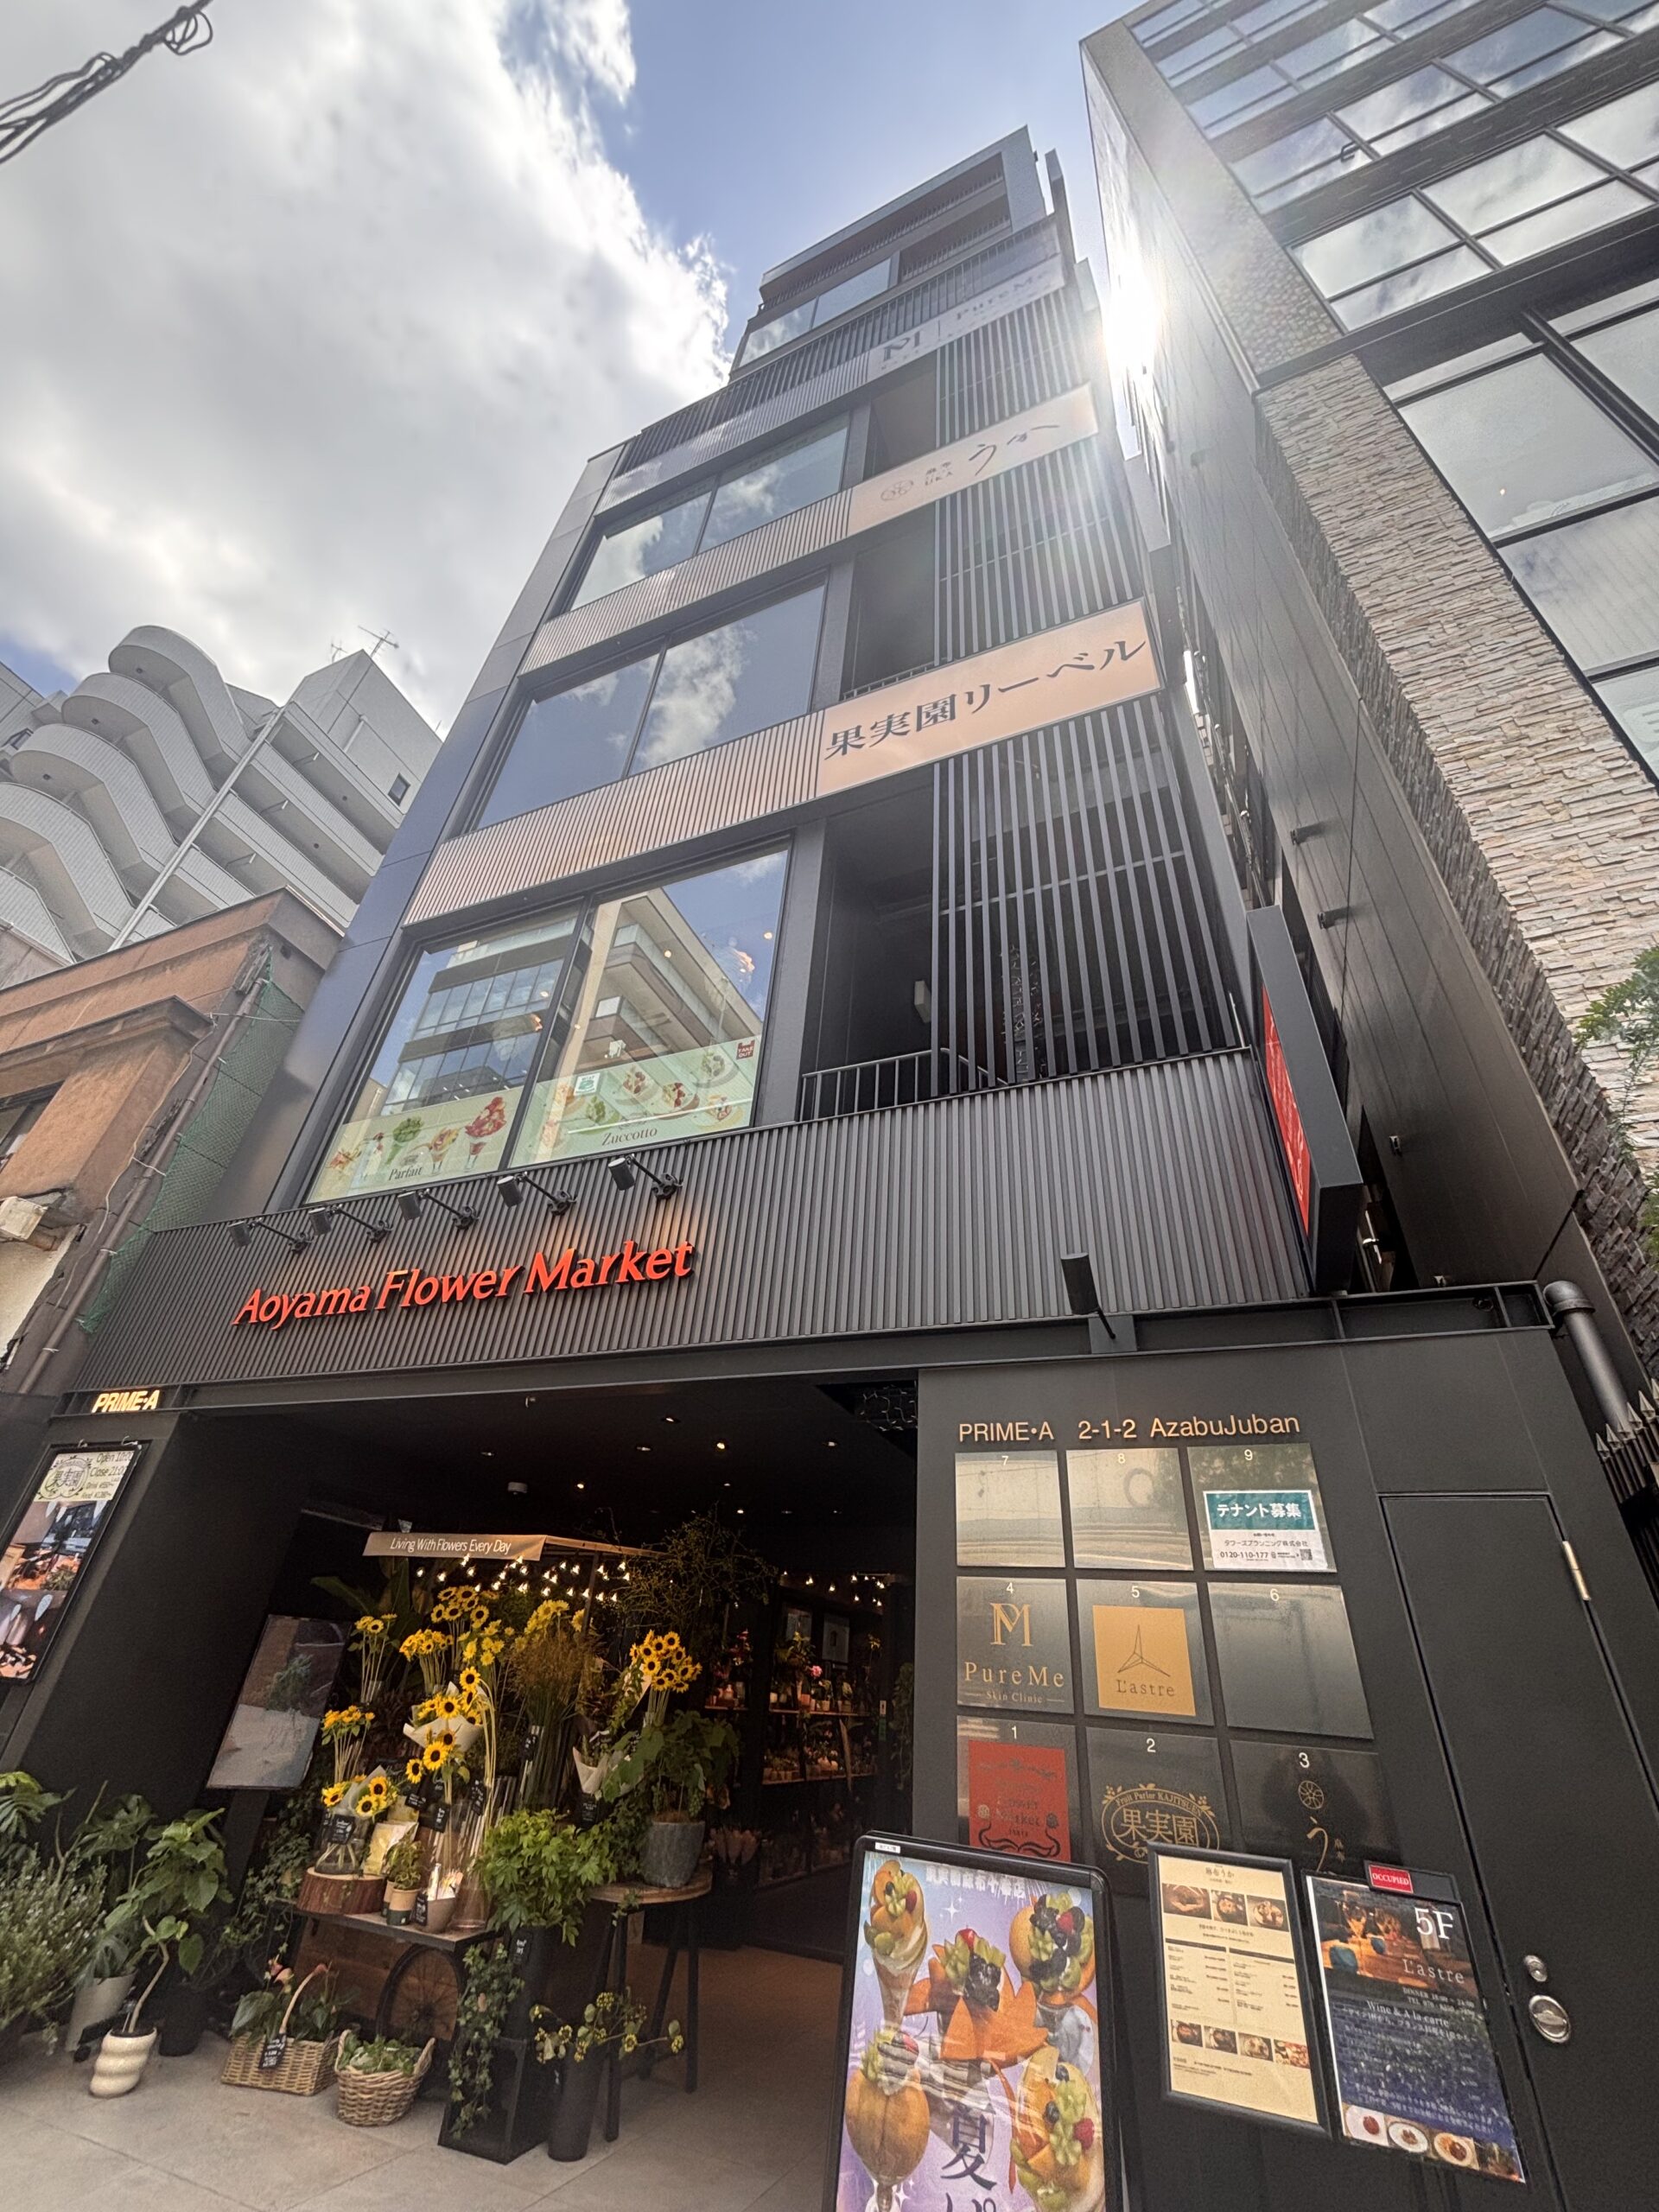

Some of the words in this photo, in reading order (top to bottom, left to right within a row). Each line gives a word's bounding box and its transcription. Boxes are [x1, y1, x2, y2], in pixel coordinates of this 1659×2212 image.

[823, 639, 1147, 761] 果実園リーベル
[601, 1127, 658, 1147] Zuccotto
[388, 1166, 423, 1181] Parfait
[232, 1282, 372, 1331] Aoyama
[375, 1263, 524, 1311] Flower
[523, 1240, 695, 1294] Market
[1077, 1419, 1137, 1440] 2-1-2
[1150, 1414, 1300, 1439] AzabuJuban
[1001, 1456, 1009, 1466] 7
[1117, 1453, 1126, 1465] 8
[1243, 1449, 1254, 1461] 9
[1217, 1503, 1301, 1518] テナント募集
[391, 1537, 416, 1553] Living
[416, 1538, 437, 1552] With
[436, 1539, 467, 1552] Flowers
[468, 1539, 493, 1554] Every
[493, 1539, 512, 1555] Day
[1006, 1581, 1014, 1594] 4
[1131, 1586, 1141, 1599] 5
[1269, 1589, 1280, 1602] 6
[986, 1691, 1008, 1700] Skin
[1011, 1692, 1044, 1704] Clinic
[1011, 1725, 1018, 1740] 1
[1146, 1738, 1156, 1754] 2
[1298, 1752, 1310, 1769] 3
[1115, 1795, 1134, 1807] Fruit
[1134, 1791, 1156, 1800] Parlor
[1113, 1808, 1200, 1847] 果実園
[1371, 1872, 1410, 1885] OCCUPIED
[1414, 1906, 1454, 1940] 5F
[1366, 2000, 1392, 2015] Wine
